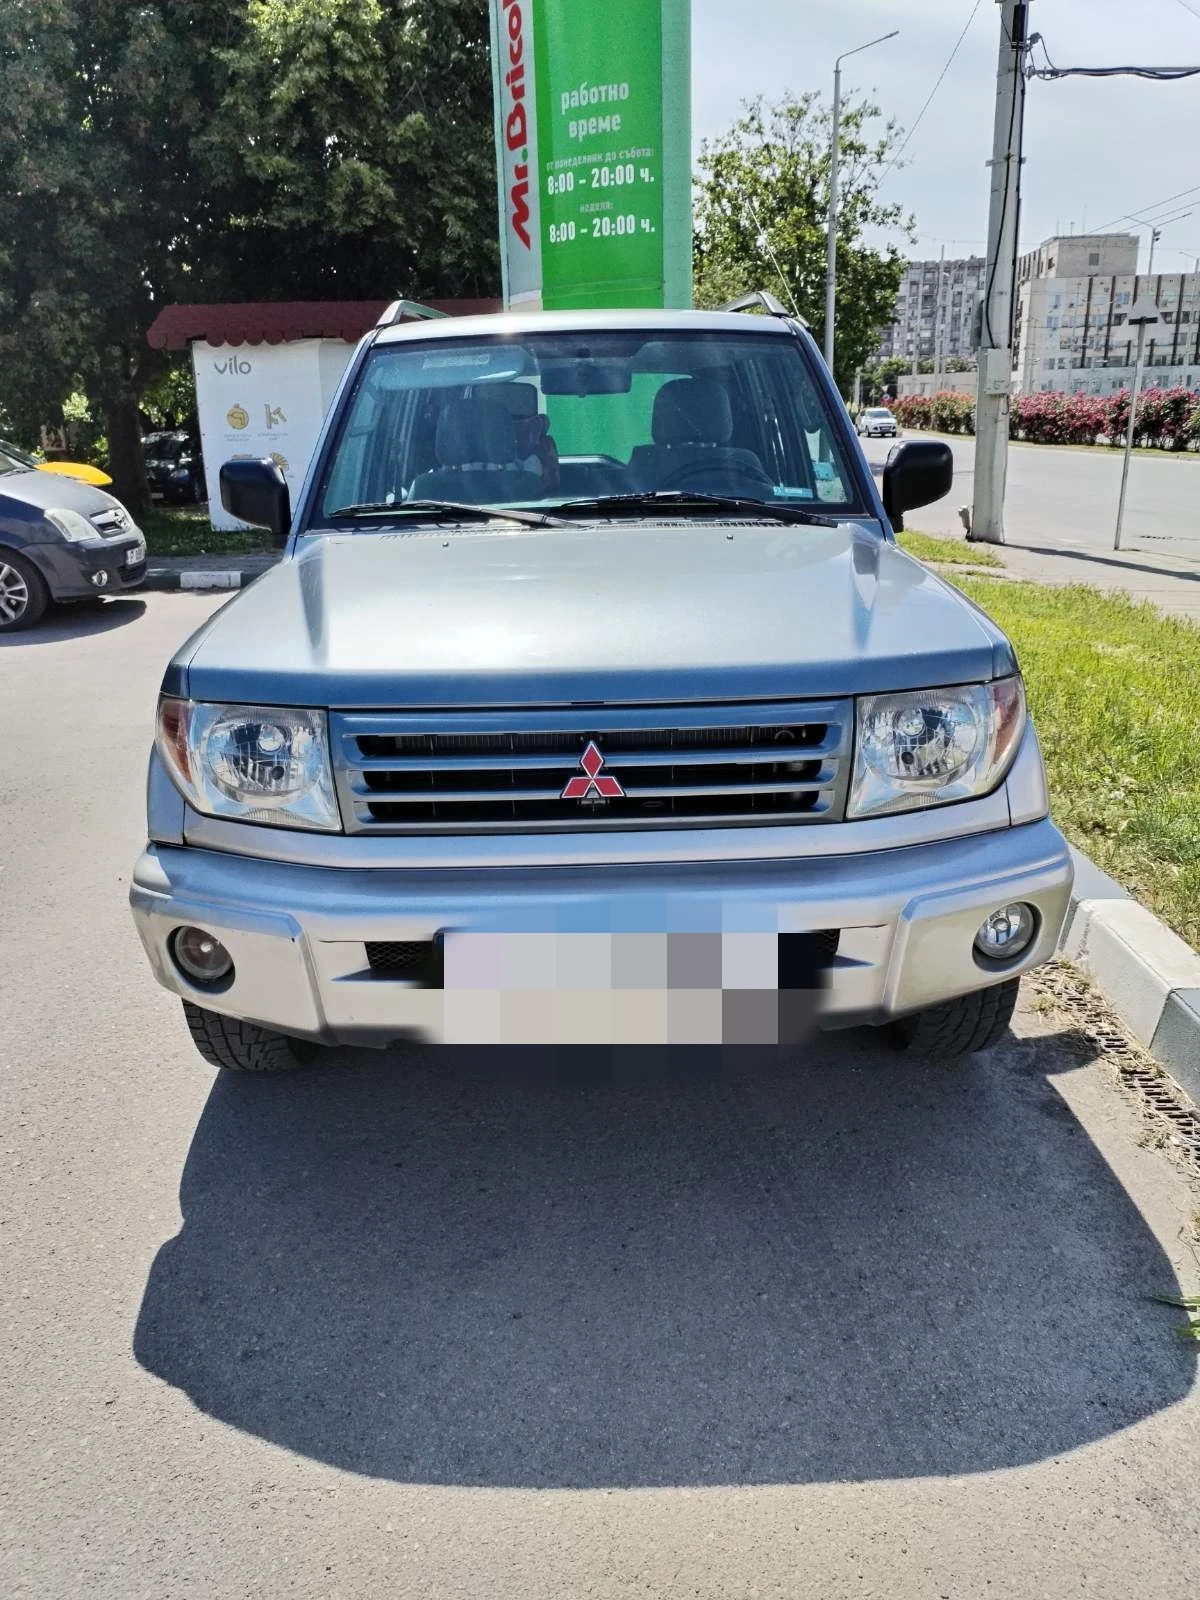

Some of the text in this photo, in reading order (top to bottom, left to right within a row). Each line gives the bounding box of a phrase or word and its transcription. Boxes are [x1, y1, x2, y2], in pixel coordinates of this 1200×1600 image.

[561, 81, 629, 115] работно
[568, 114, 621, 142] време
[548, 171, 574, 195] 8:00
[591, 163, 635, 188] 20:00
[640, 167, 655, 182] ч.
[549, 221, 576, 243] 8:00
[592, 214, 636, 237] 20:00
[640, 218, 655, 232] ч.
[214, 355, 252, 375] vilo
